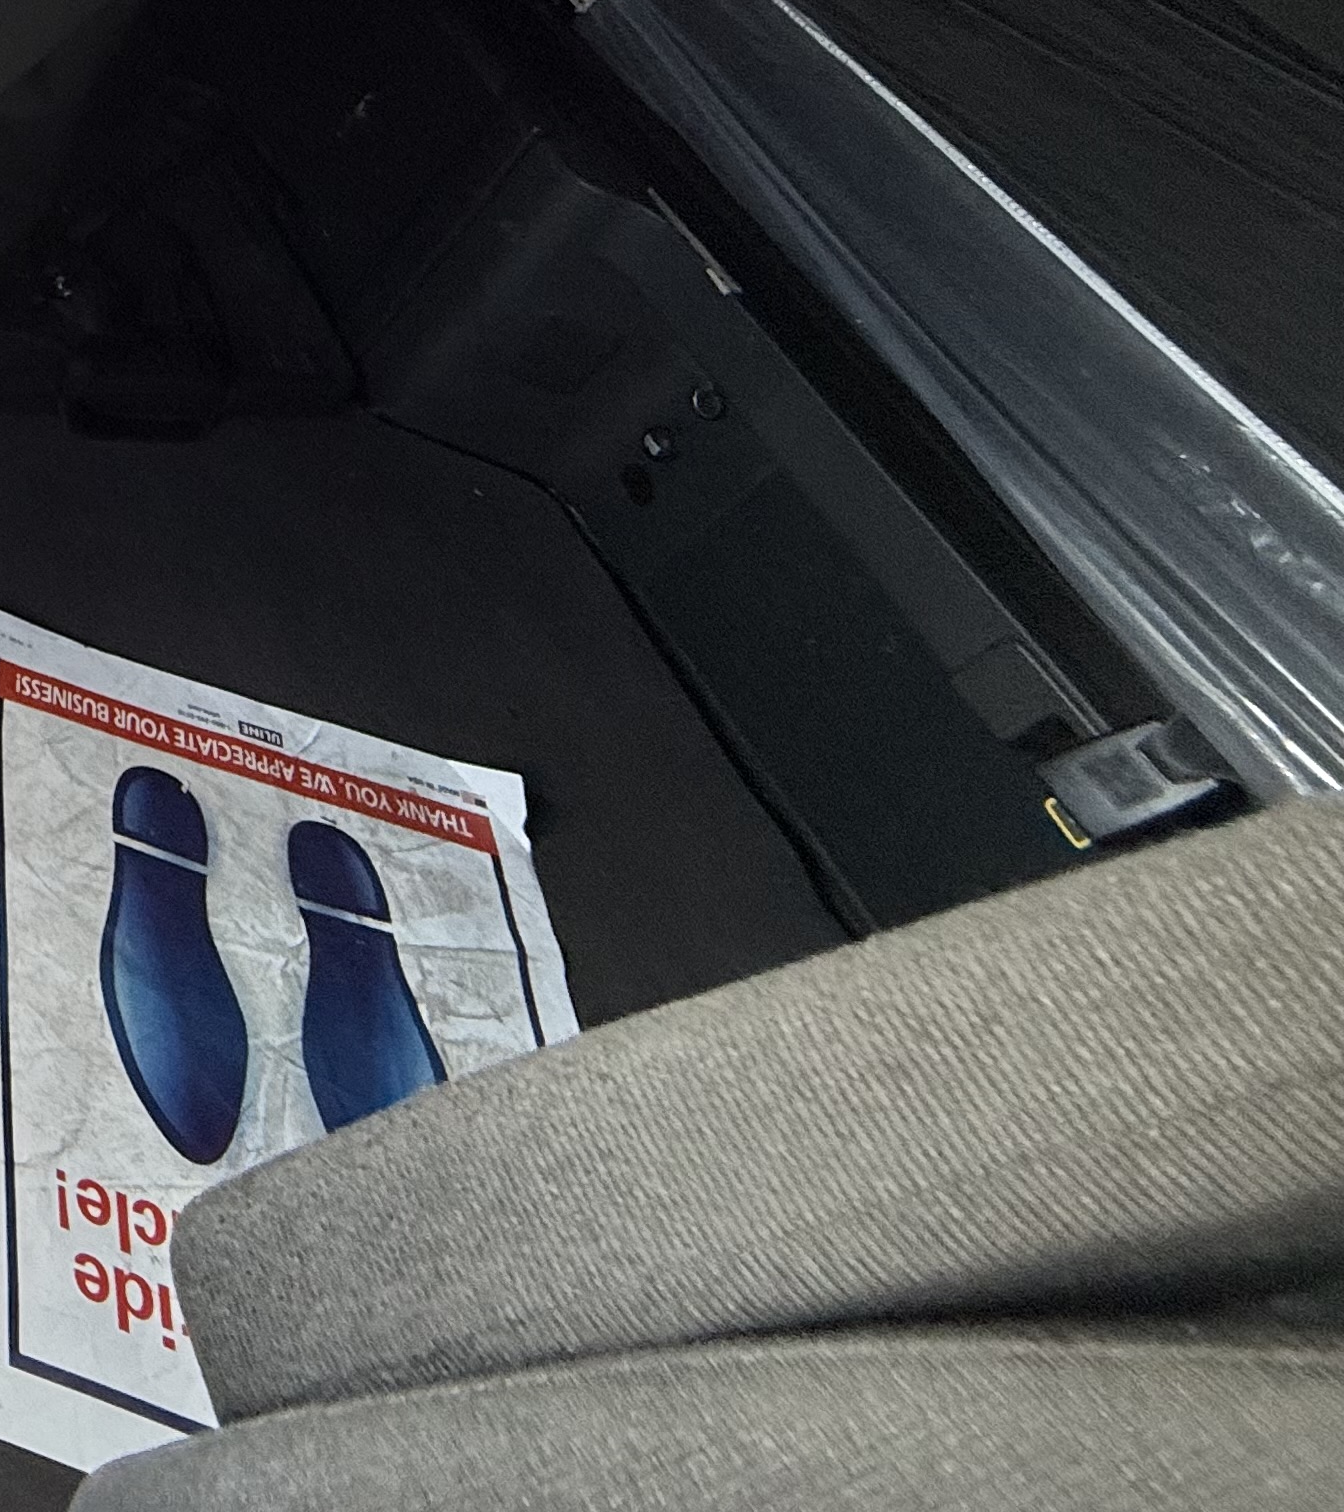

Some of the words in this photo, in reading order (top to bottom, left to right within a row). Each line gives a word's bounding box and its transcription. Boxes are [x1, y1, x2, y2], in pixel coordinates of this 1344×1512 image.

[16, 675, 108, 721] BUSINESS!
[114, 708, 167, 741] YOUR
[238, 721, 280, 744] ULINE
[175, 729, 294, 780] APPRECIATE
[302, 768, 335, 794] WE
[334, 778, 389, 809] YOU,
[397, 800, 471, 837] THANK
[56, 1169, 183, 1255] cle!
[74, 1253, 191, 1351] ide
